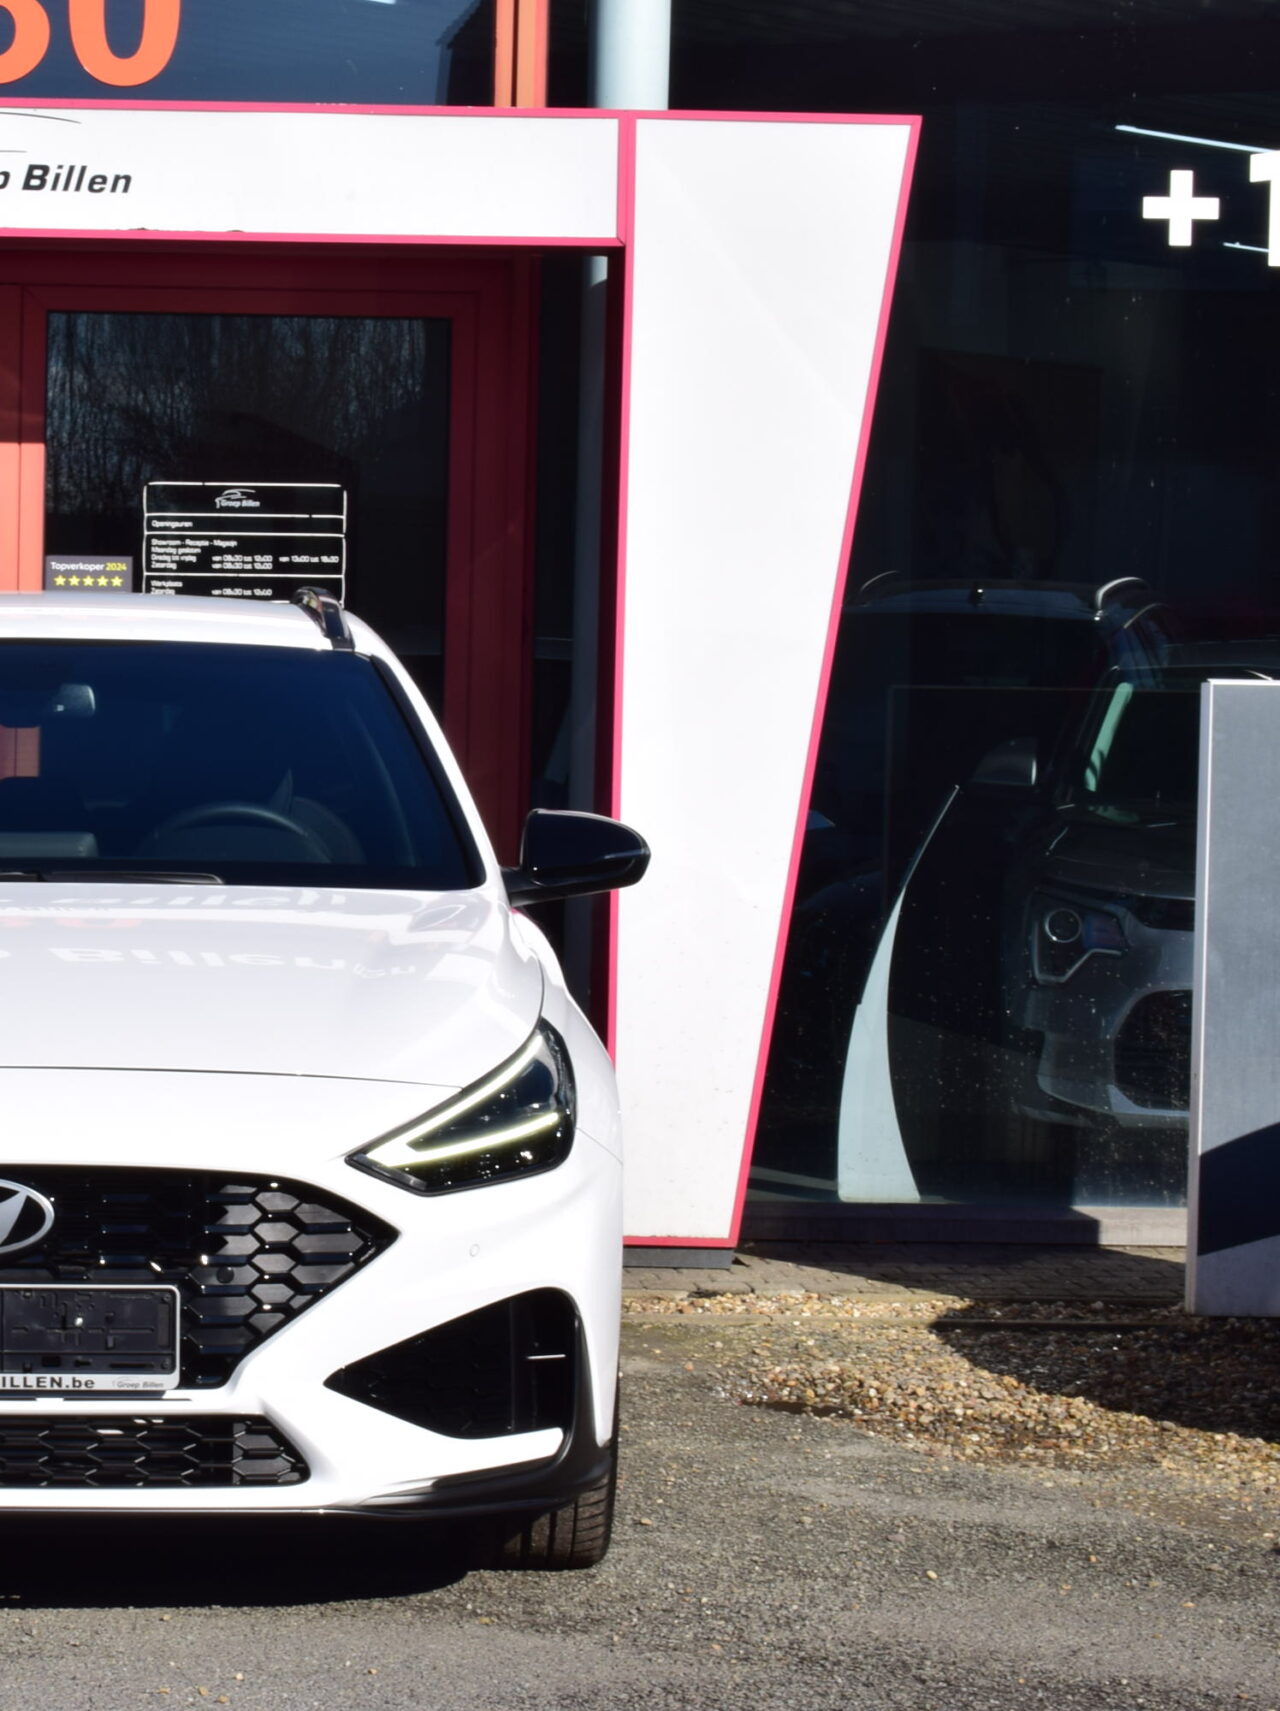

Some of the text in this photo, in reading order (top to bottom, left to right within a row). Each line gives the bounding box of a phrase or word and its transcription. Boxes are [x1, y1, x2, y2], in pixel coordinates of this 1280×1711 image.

[21, 164, 132, 193] Billen
[221, 499, 240, 508] Groep
[50, 561, 127, 572] Topverkoper 2024
[117, 1380, 140, 1389] Groep
